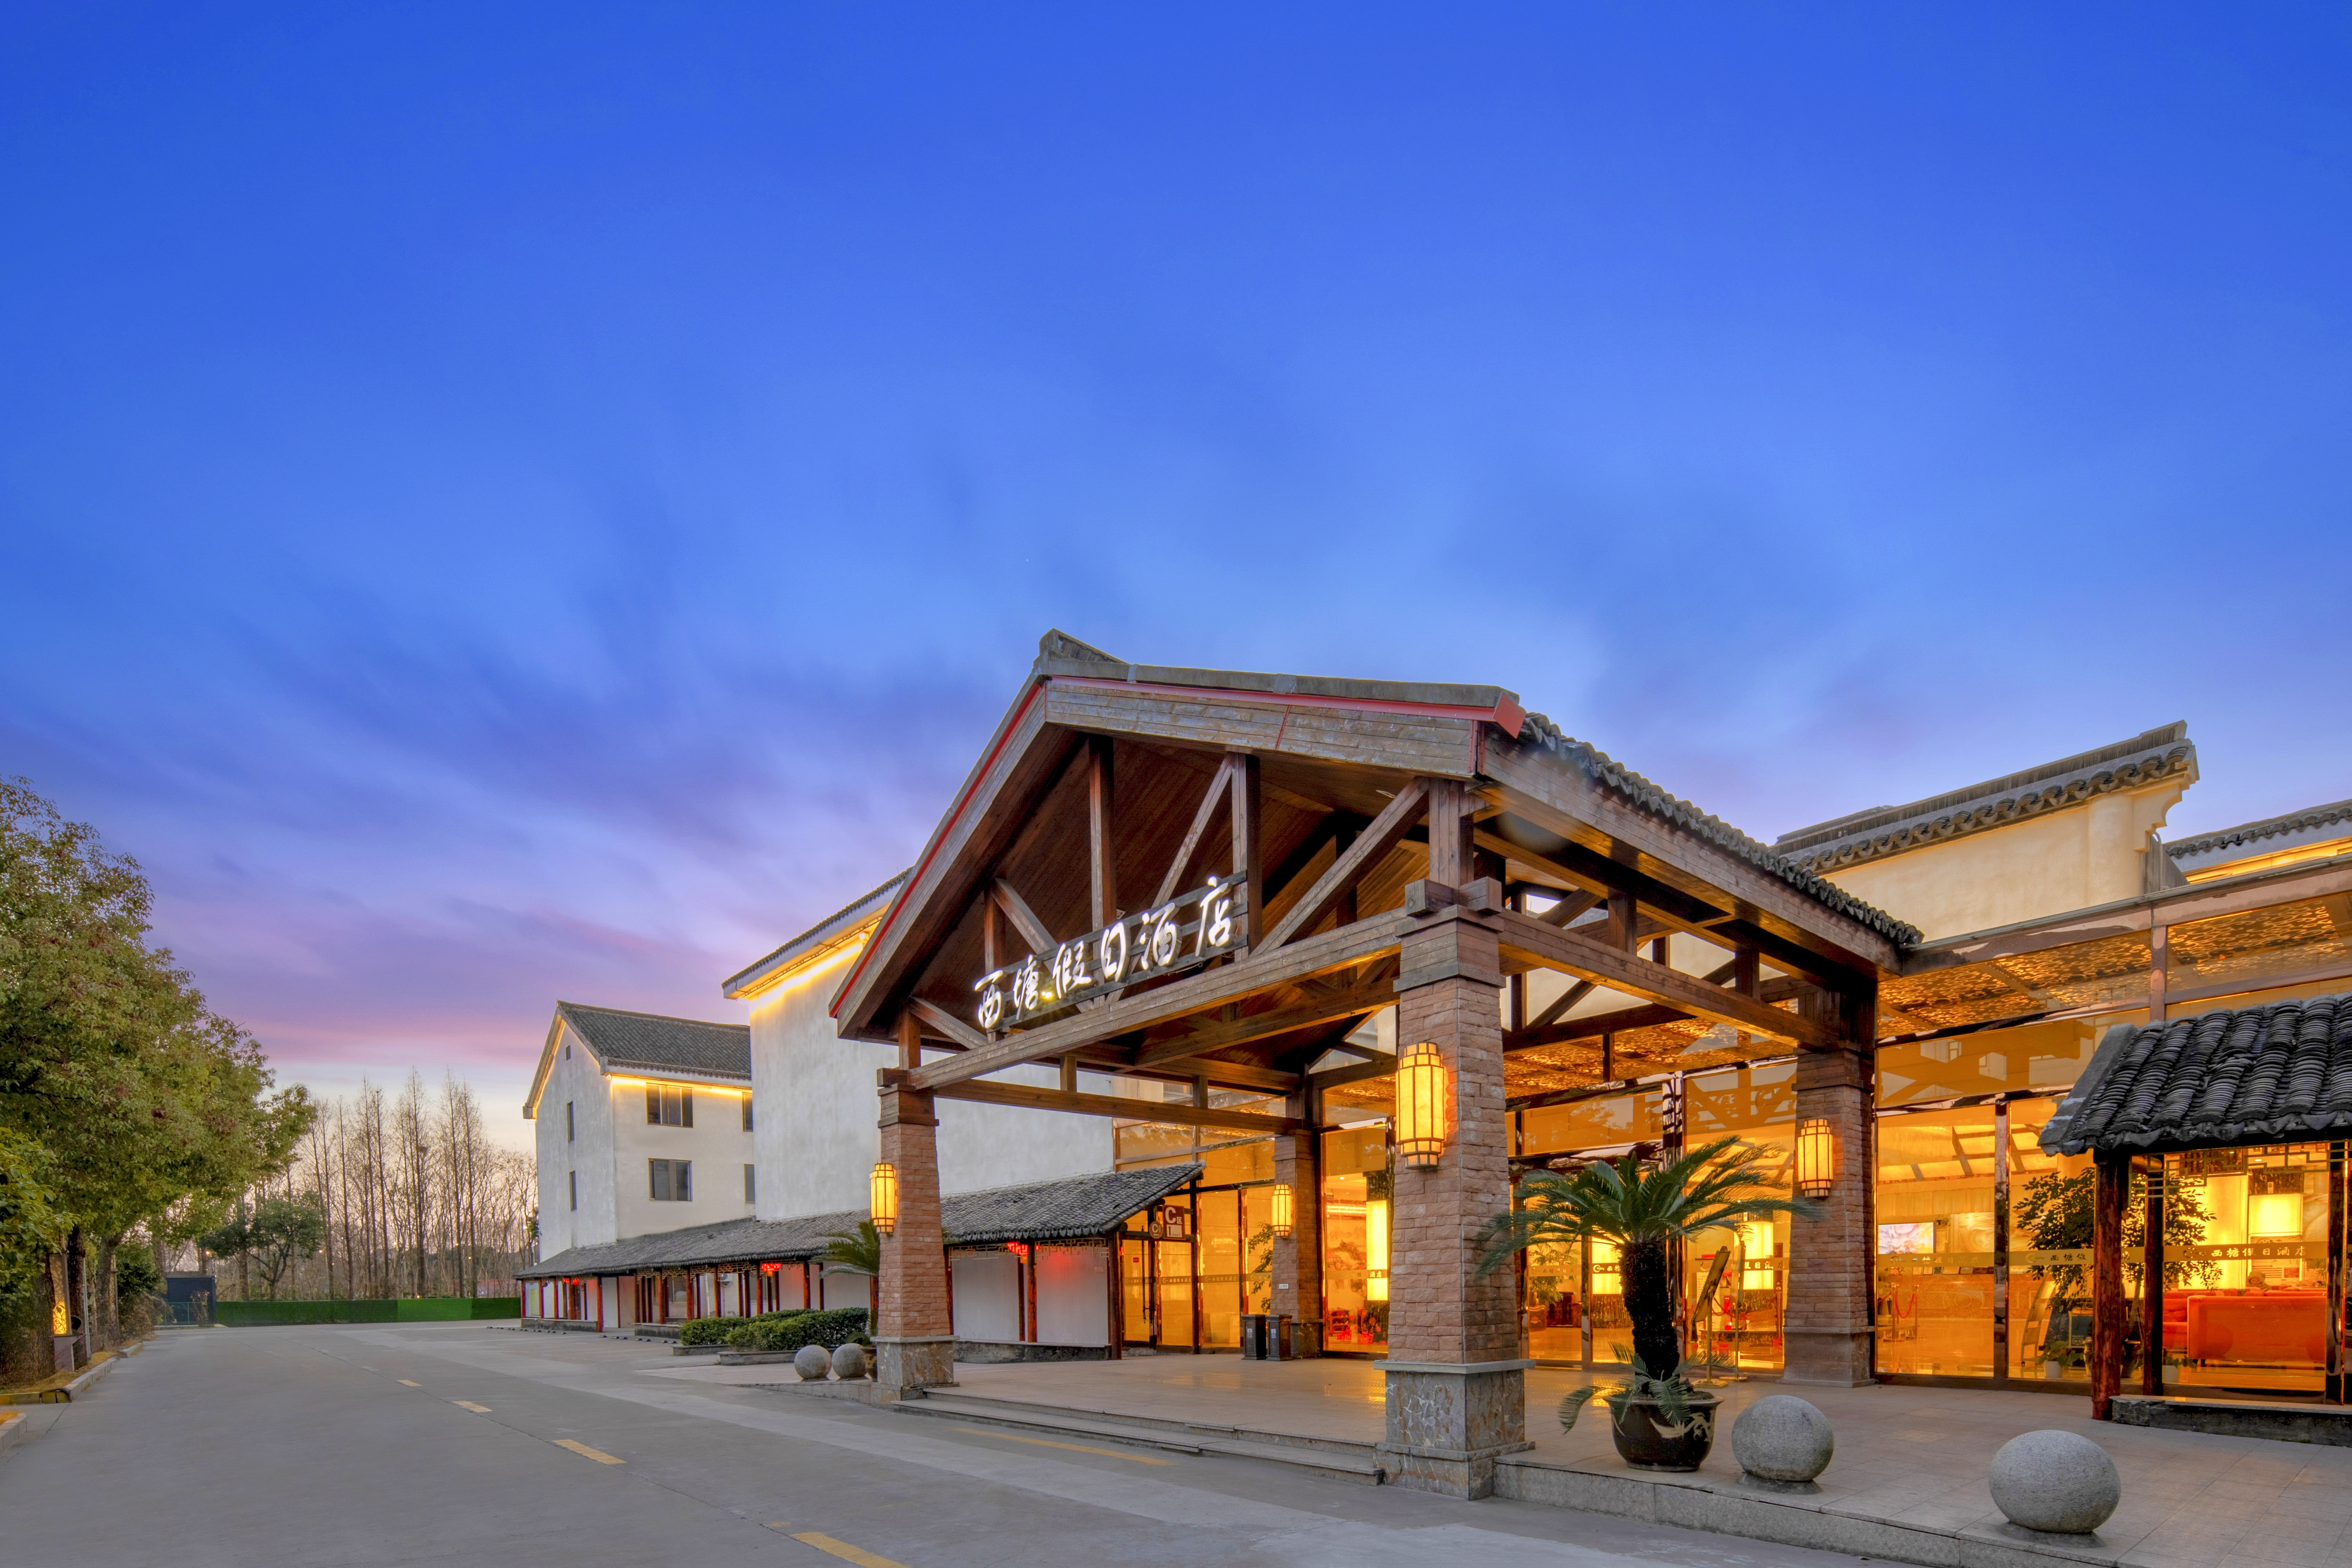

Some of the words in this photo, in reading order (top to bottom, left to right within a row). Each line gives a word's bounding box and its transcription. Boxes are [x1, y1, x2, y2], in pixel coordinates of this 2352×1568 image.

[974, 875, 1231, 1029] 西塘假日酒店
[2211, 1246, 2306, 1258] 西塘假日酒店
